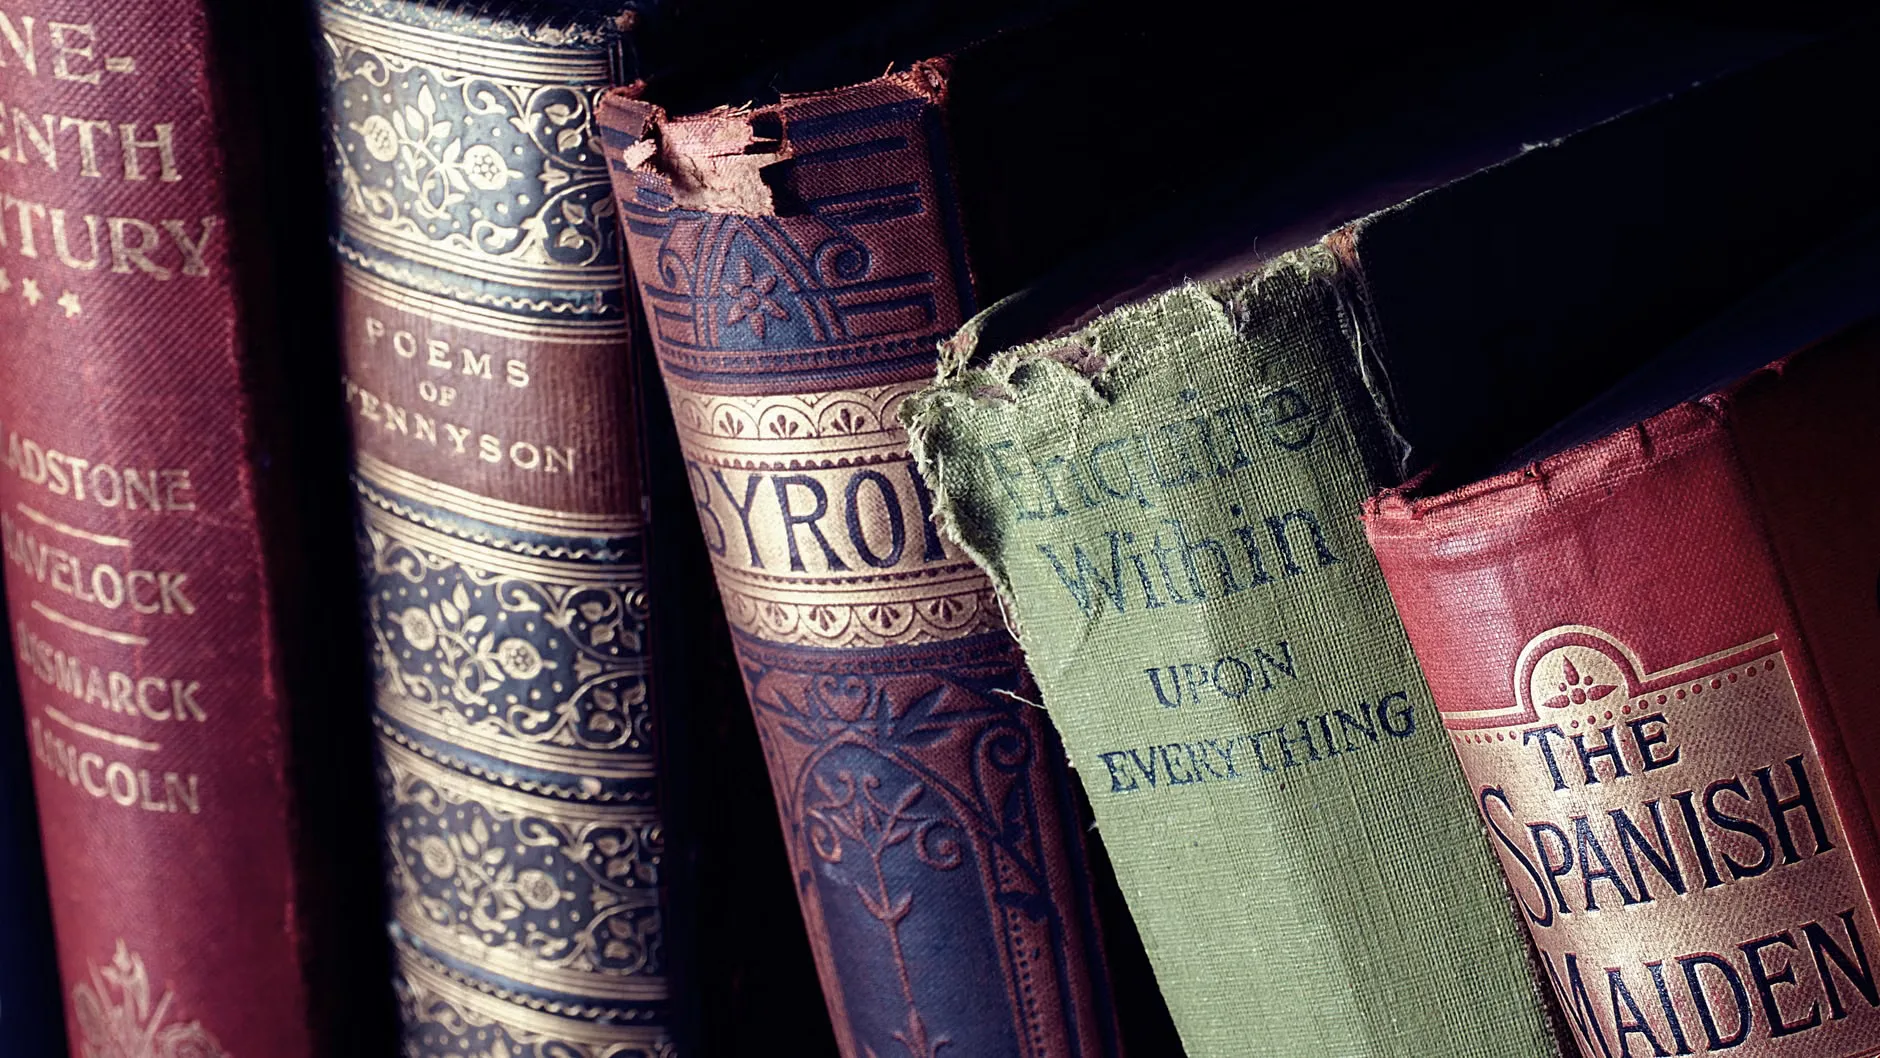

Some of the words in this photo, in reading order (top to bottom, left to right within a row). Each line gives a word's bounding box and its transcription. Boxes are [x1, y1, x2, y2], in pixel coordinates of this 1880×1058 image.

[0, 101, 183, 183] NTH
[0, 194, 218, 281] TURY
[365, 316, 530, 388] POEMS
[418, 380, 458, 407] OF
[341, 375, 576, 474] TENNYSON
[985, 386, 1319, 521] Enquire
[1036, 504, 1345, 624] Within
[1145, 640, 1299, 708] UPON
[1098, 690, 1418, 794] EVERYTHING
[1523, 712, 1680, 792] THE
[1478, 752, 1836, 928] SPANISH
[1540, 906, 1880, 1058] MAIDEN
